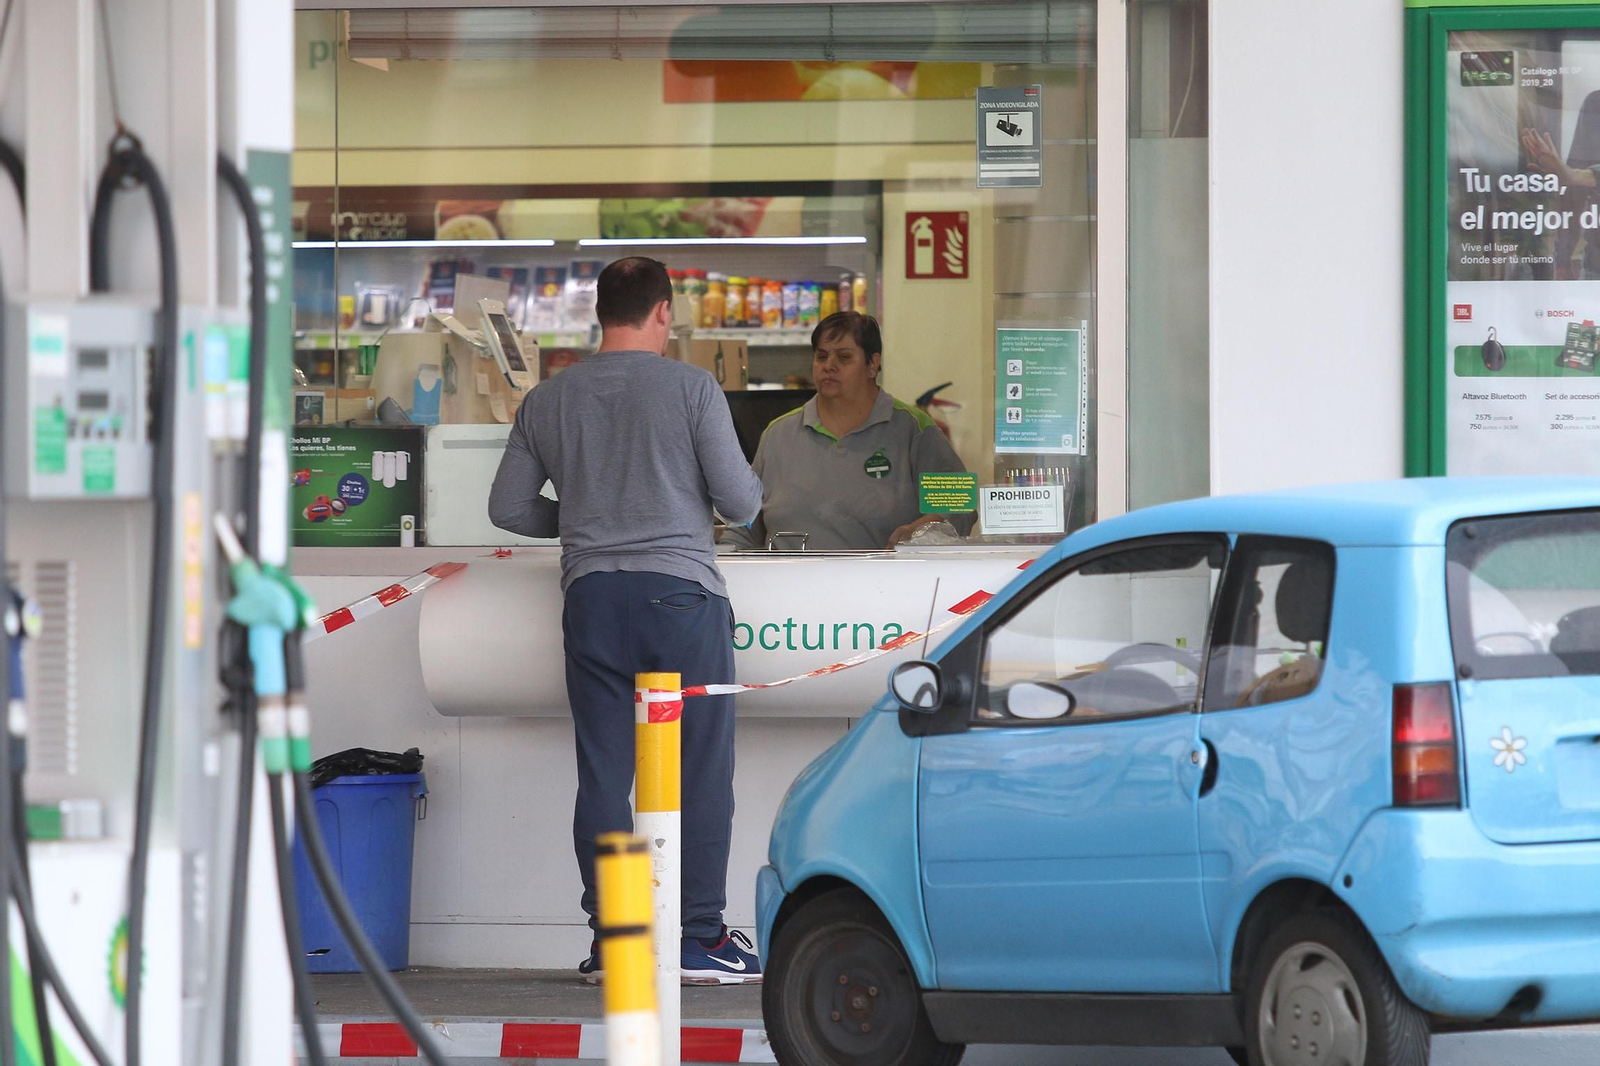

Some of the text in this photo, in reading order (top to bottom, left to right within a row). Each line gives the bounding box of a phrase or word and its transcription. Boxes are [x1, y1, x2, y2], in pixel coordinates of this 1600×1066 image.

[1521, 67, 1557, 76] Catálogo
[1521, 79, 1553, 87] 2019_20
[996, 101, 1039, 109] VIDEOVIGILADA
[1460, 168, 1567, 196] Tu casa,
[1461, 204, 1600, 236] el mejor d
[1461, 243, 1518, 254] Vive el lugar
[1461, 255, 1554, 265] donde ser tú mismo
[1547, 310, 1575, 318] BOSCH
[1463, 392, 1527, 400] Altavoz Bluetooth
[1545, 392, 1558, 400] Set
[300, 444, 325, 452] quieres,
[990, 490, 1050, 501] PROHIBIDO
